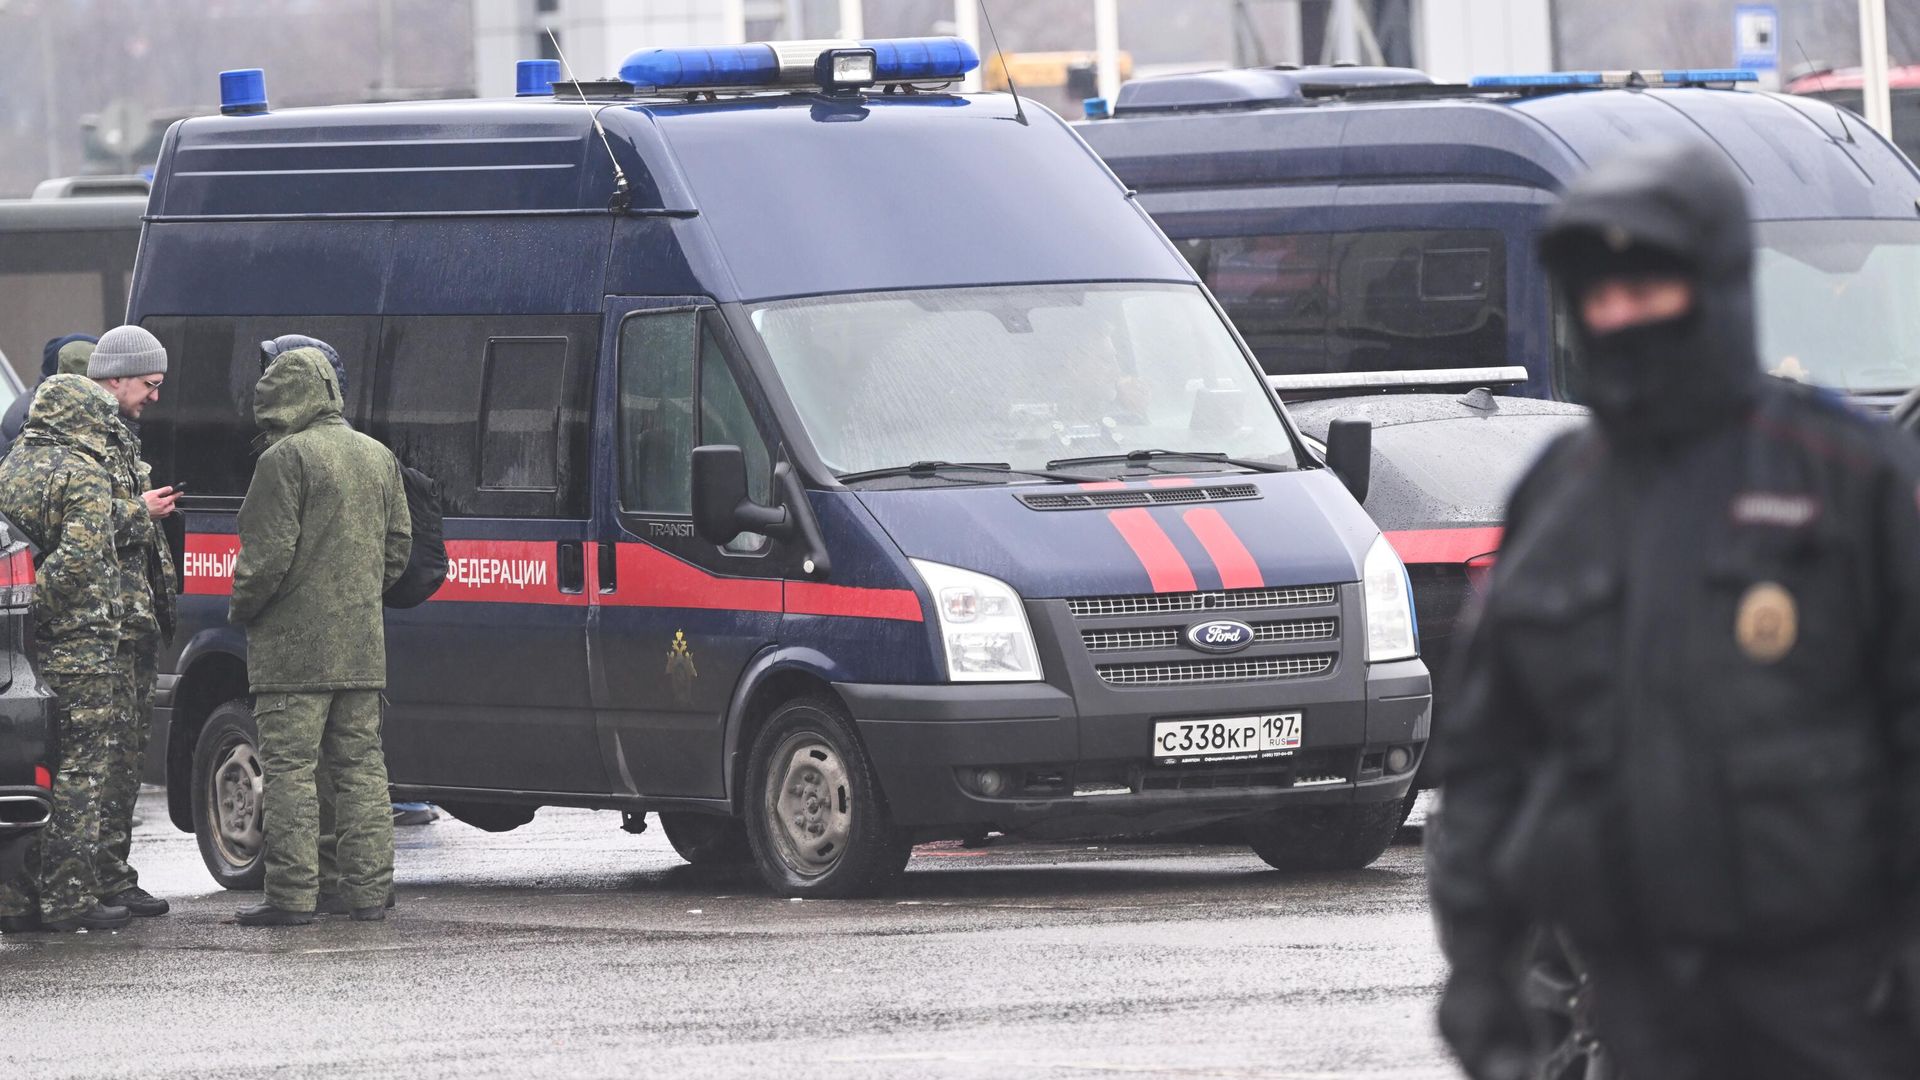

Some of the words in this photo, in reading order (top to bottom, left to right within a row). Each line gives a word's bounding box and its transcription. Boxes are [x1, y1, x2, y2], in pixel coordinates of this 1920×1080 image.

[183, 548, 237, 578] ЕННЫЙ
[446, 558, 547, 590] ФЕДЕРАЦИИ
[1206, 625, 1241, 643] Ford
[1162, 723, 1256, 752] С338КР
[1262, 716, 1295, 739] 197
[1269, 738, 1286, 746] RUS
